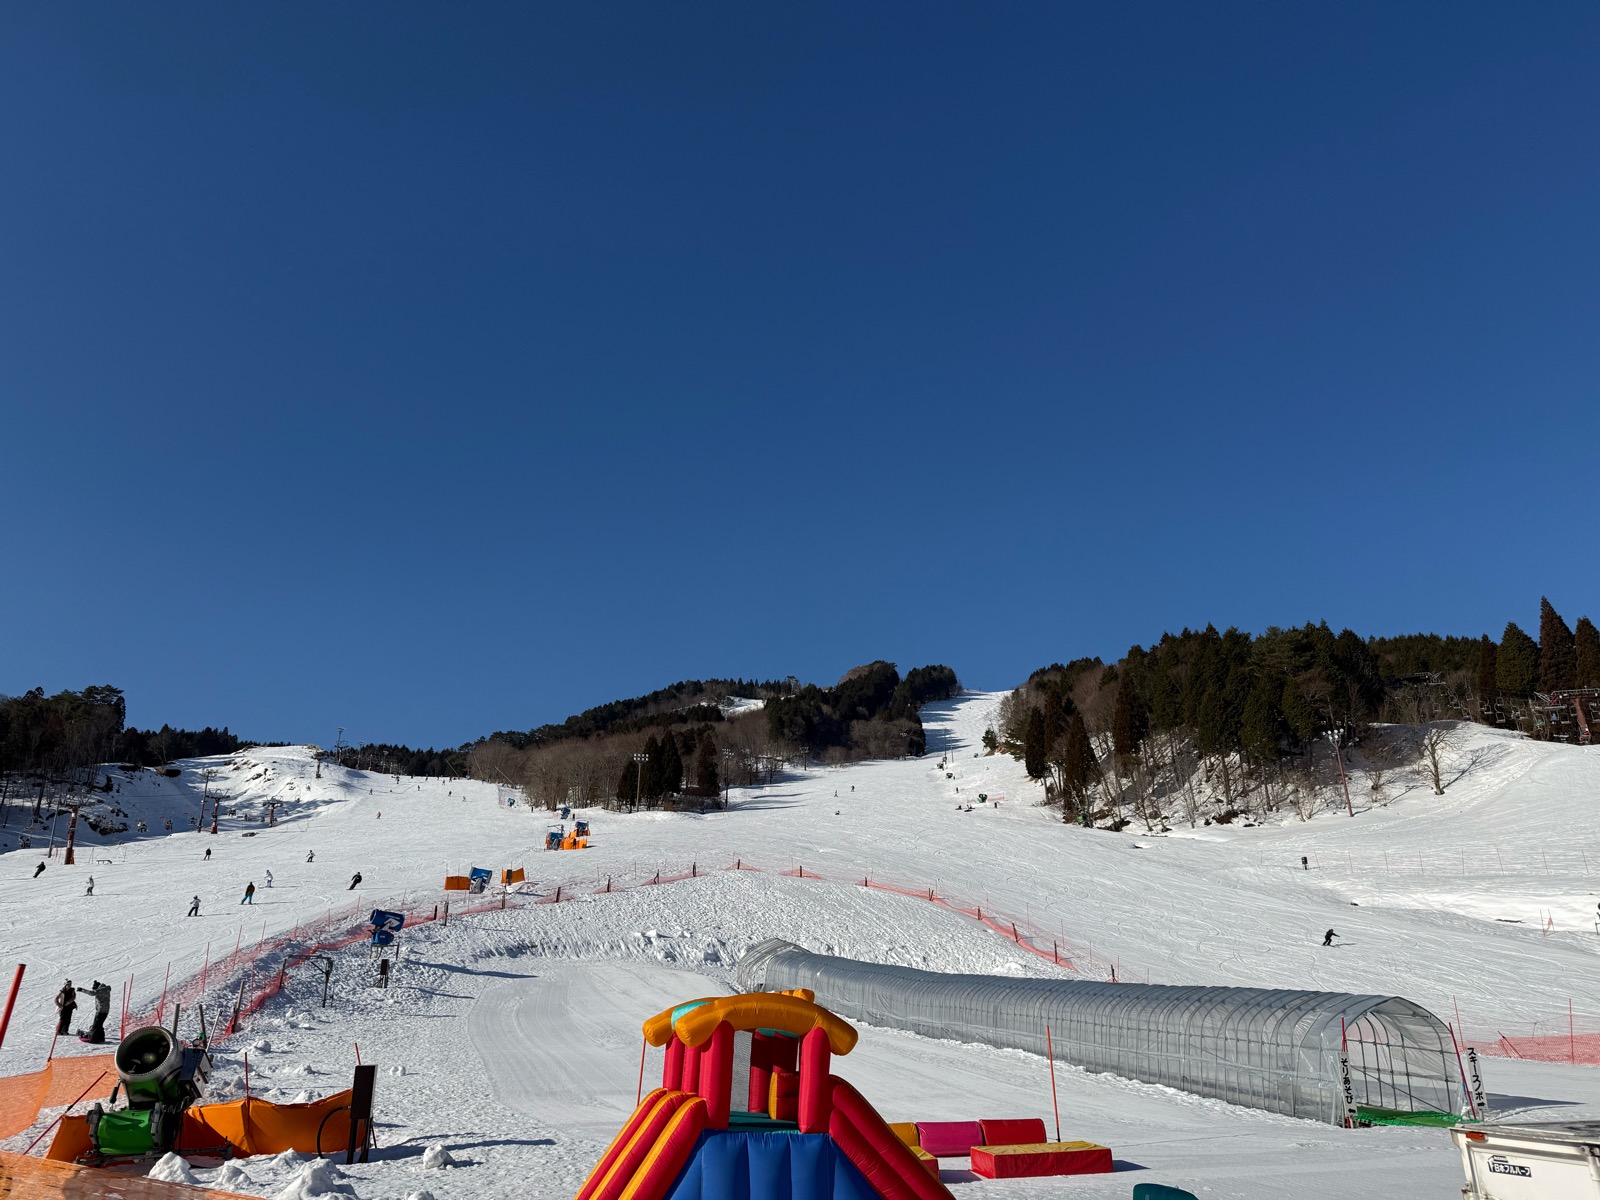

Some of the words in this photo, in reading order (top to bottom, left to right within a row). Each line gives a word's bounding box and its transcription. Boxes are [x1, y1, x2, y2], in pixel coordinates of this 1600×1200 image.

[1341, 1057, 1354, 1105] そりあそび
[1467, 1047, 1484, 1101] スキースノボ
[1494, 1163, 1531, 1176] 日本フルハーフ
